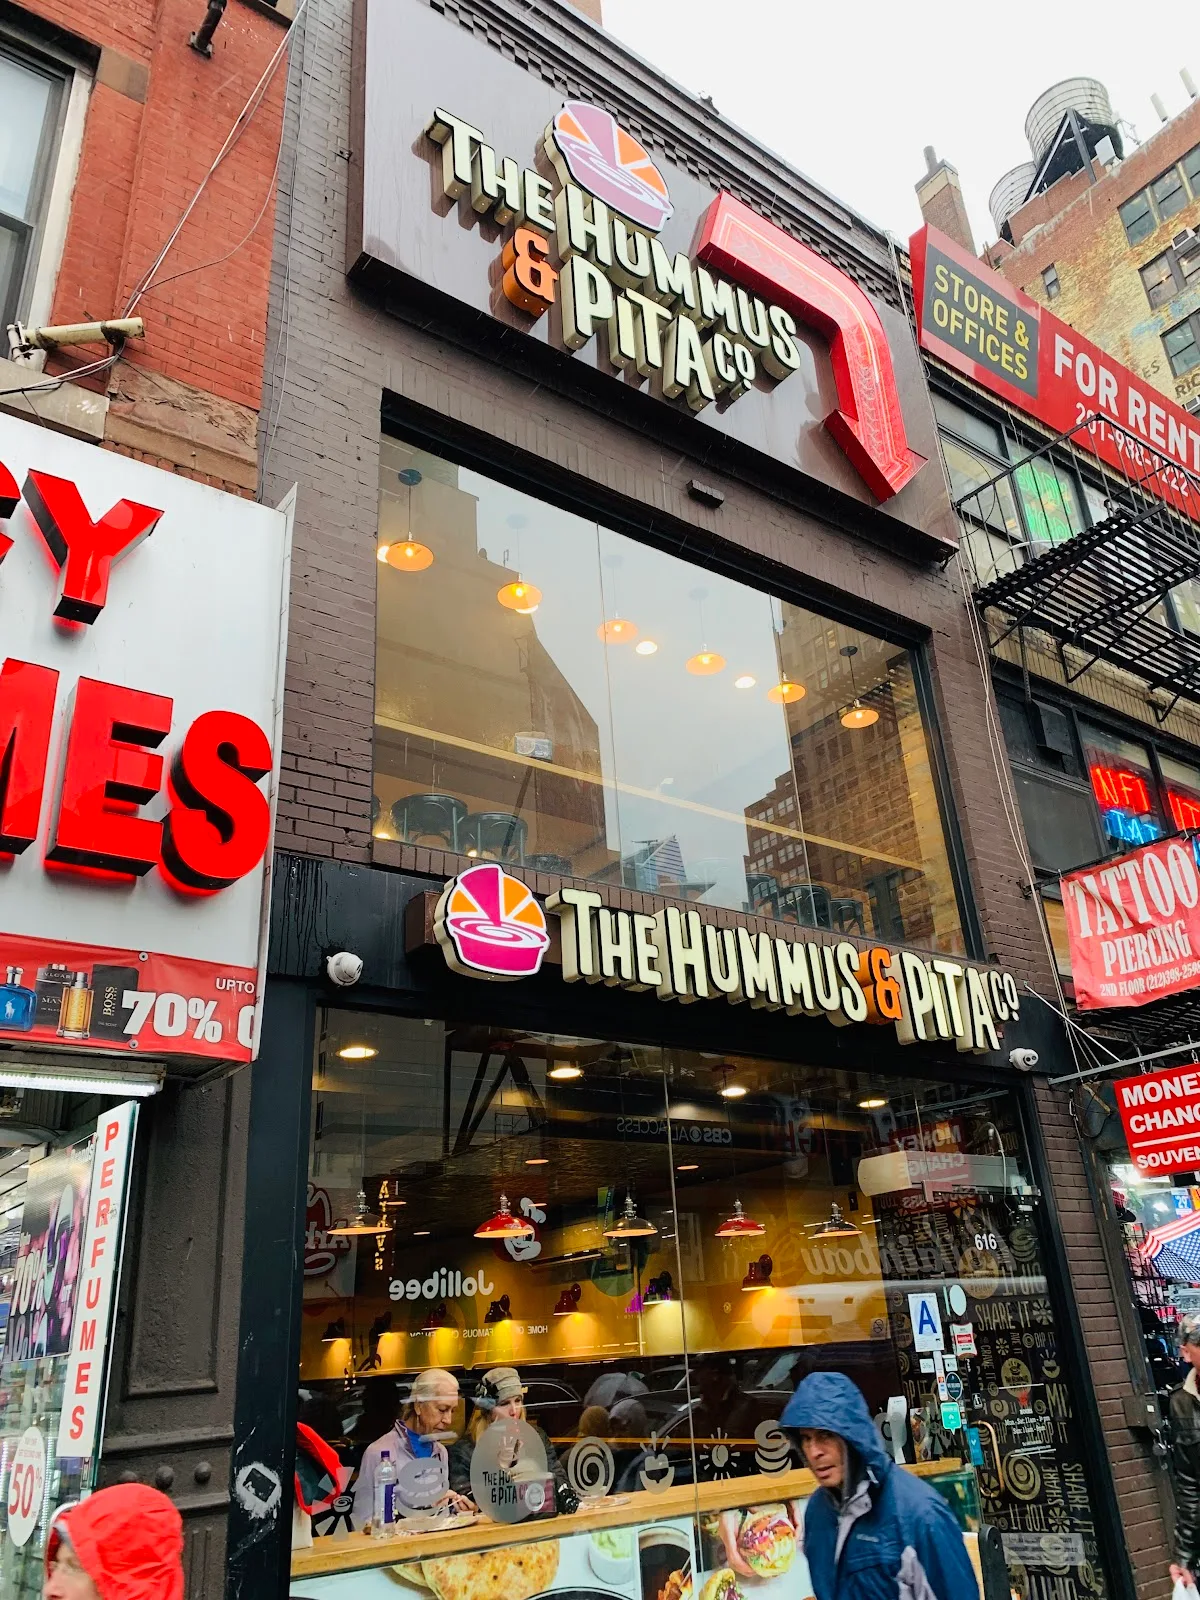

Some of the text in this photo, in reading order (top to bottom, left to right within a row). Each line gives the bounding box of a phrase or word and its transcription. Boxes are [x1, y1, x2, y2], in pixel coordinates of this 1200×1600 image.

[505, 226, 557, 308] &
[563, 183, 800, 373] HUMMUS
[934, 264, 1031, 351] STORE &
[933, 298, 1029, 381] OFFICES
[1054, 333, 1200, 473] FOR RENT
[0, 459, 164, 625] Y
[1068, 843, 1198, 938] TATTOO
[662, 906, 868, 1023] HUMMUS
[864, 946, 904, 1022] &
[1100, 919, 1193, 977] PIERCING
[102, 986, 115, 1017] BOSS
[215, 977, 255, 994] UPTO
[1100, 982, 1118, 997] 2ND
[1119, 977, 1146, 997] FLOOR
[122, 989, 223, 1044] 70%
[1121, 1070, 1200, 1108] MONE
[974, 1233, 998, 1251] 616
[69, 1120, 121, 1441] PERFUMES
[918, 1300, 938, 1335] A
[975, 1300, 1031, 1332] SHARE IT
[980, 1344, 995, 1370] CRAVE
[1034, 1331, 1057, 1348] DIP IT
[482, 1471, 498, 1487] THE
[498, 1485, 518, 1506] PITA
[1040, 1465, 1065, 1506] SHARE
[1061, 1462, 1091, 1513] SHARE
[1025, 1503, 1050, 1532] TOP
[1072, 1519, 1096, 1538] IT
